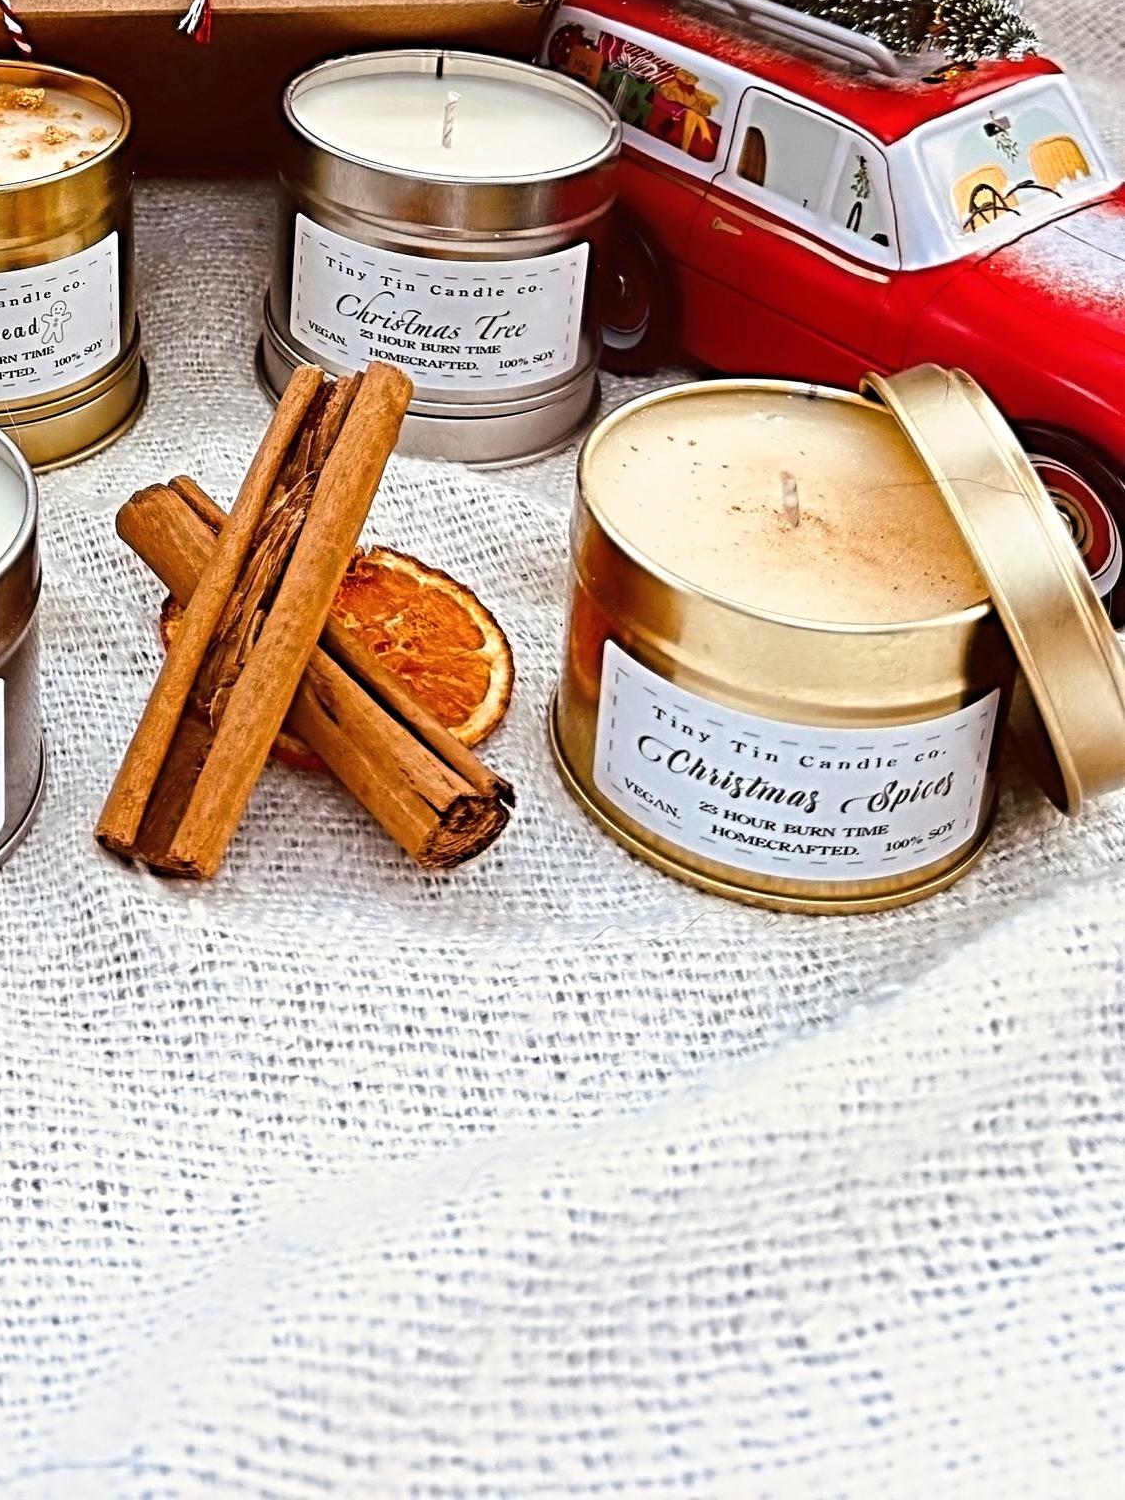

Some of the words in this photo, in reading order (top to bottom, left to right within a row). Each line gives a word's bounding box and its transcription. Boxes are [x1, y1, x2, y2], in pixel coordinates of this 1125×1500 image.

[62, 280, 86, 293] co.
[325, 256, 367, 281] Tiny
[380, 275, 416, 292] Tin
[429, 285, 505, 298] Candle
[517, 284, 544, 294] co.
[335, 291, 461, 340] Christmas
[475, 310, 527, 340] Tree
[21, 345, 55, 361] TIME
[54, 353, 81, 368] 100%
[83, 339, 104, 356] SOY
[308, 320, 348, 347] VEGAN.
[369, 347, 479, 371] HOMECRAFTED.
[498, 358, 529, 369] 100%
[533, 349, 555, 364] SOY
[359, 329, 374, 340] 23
[377, 334, 416, 350] HOUR
[420, 342, 460, 355] BURN
[464, 345, 501, 355] TIME
[652, 705, 712, 743] Tiny
[731, 739, 779, 764] Tin
[799, 755, 898, 770] Candle
[914, 748, 947, 765] co.
[637, 733, 820, 814] Christmas
[840, 770, 956, 814] Spices
[623, 777, 682, 819] VEGAN.
[710, 824, 861, 856] HOMECRAFTED.
[884, 834, 924, 852] 100%
[926, 819, 957, 841] SOY
[698, 801, 718, 816] 23
[723, 809, 778, 832] HOUR
[782, 822, 836, 838] BURN
[842, 823, 890, 837] TIME
